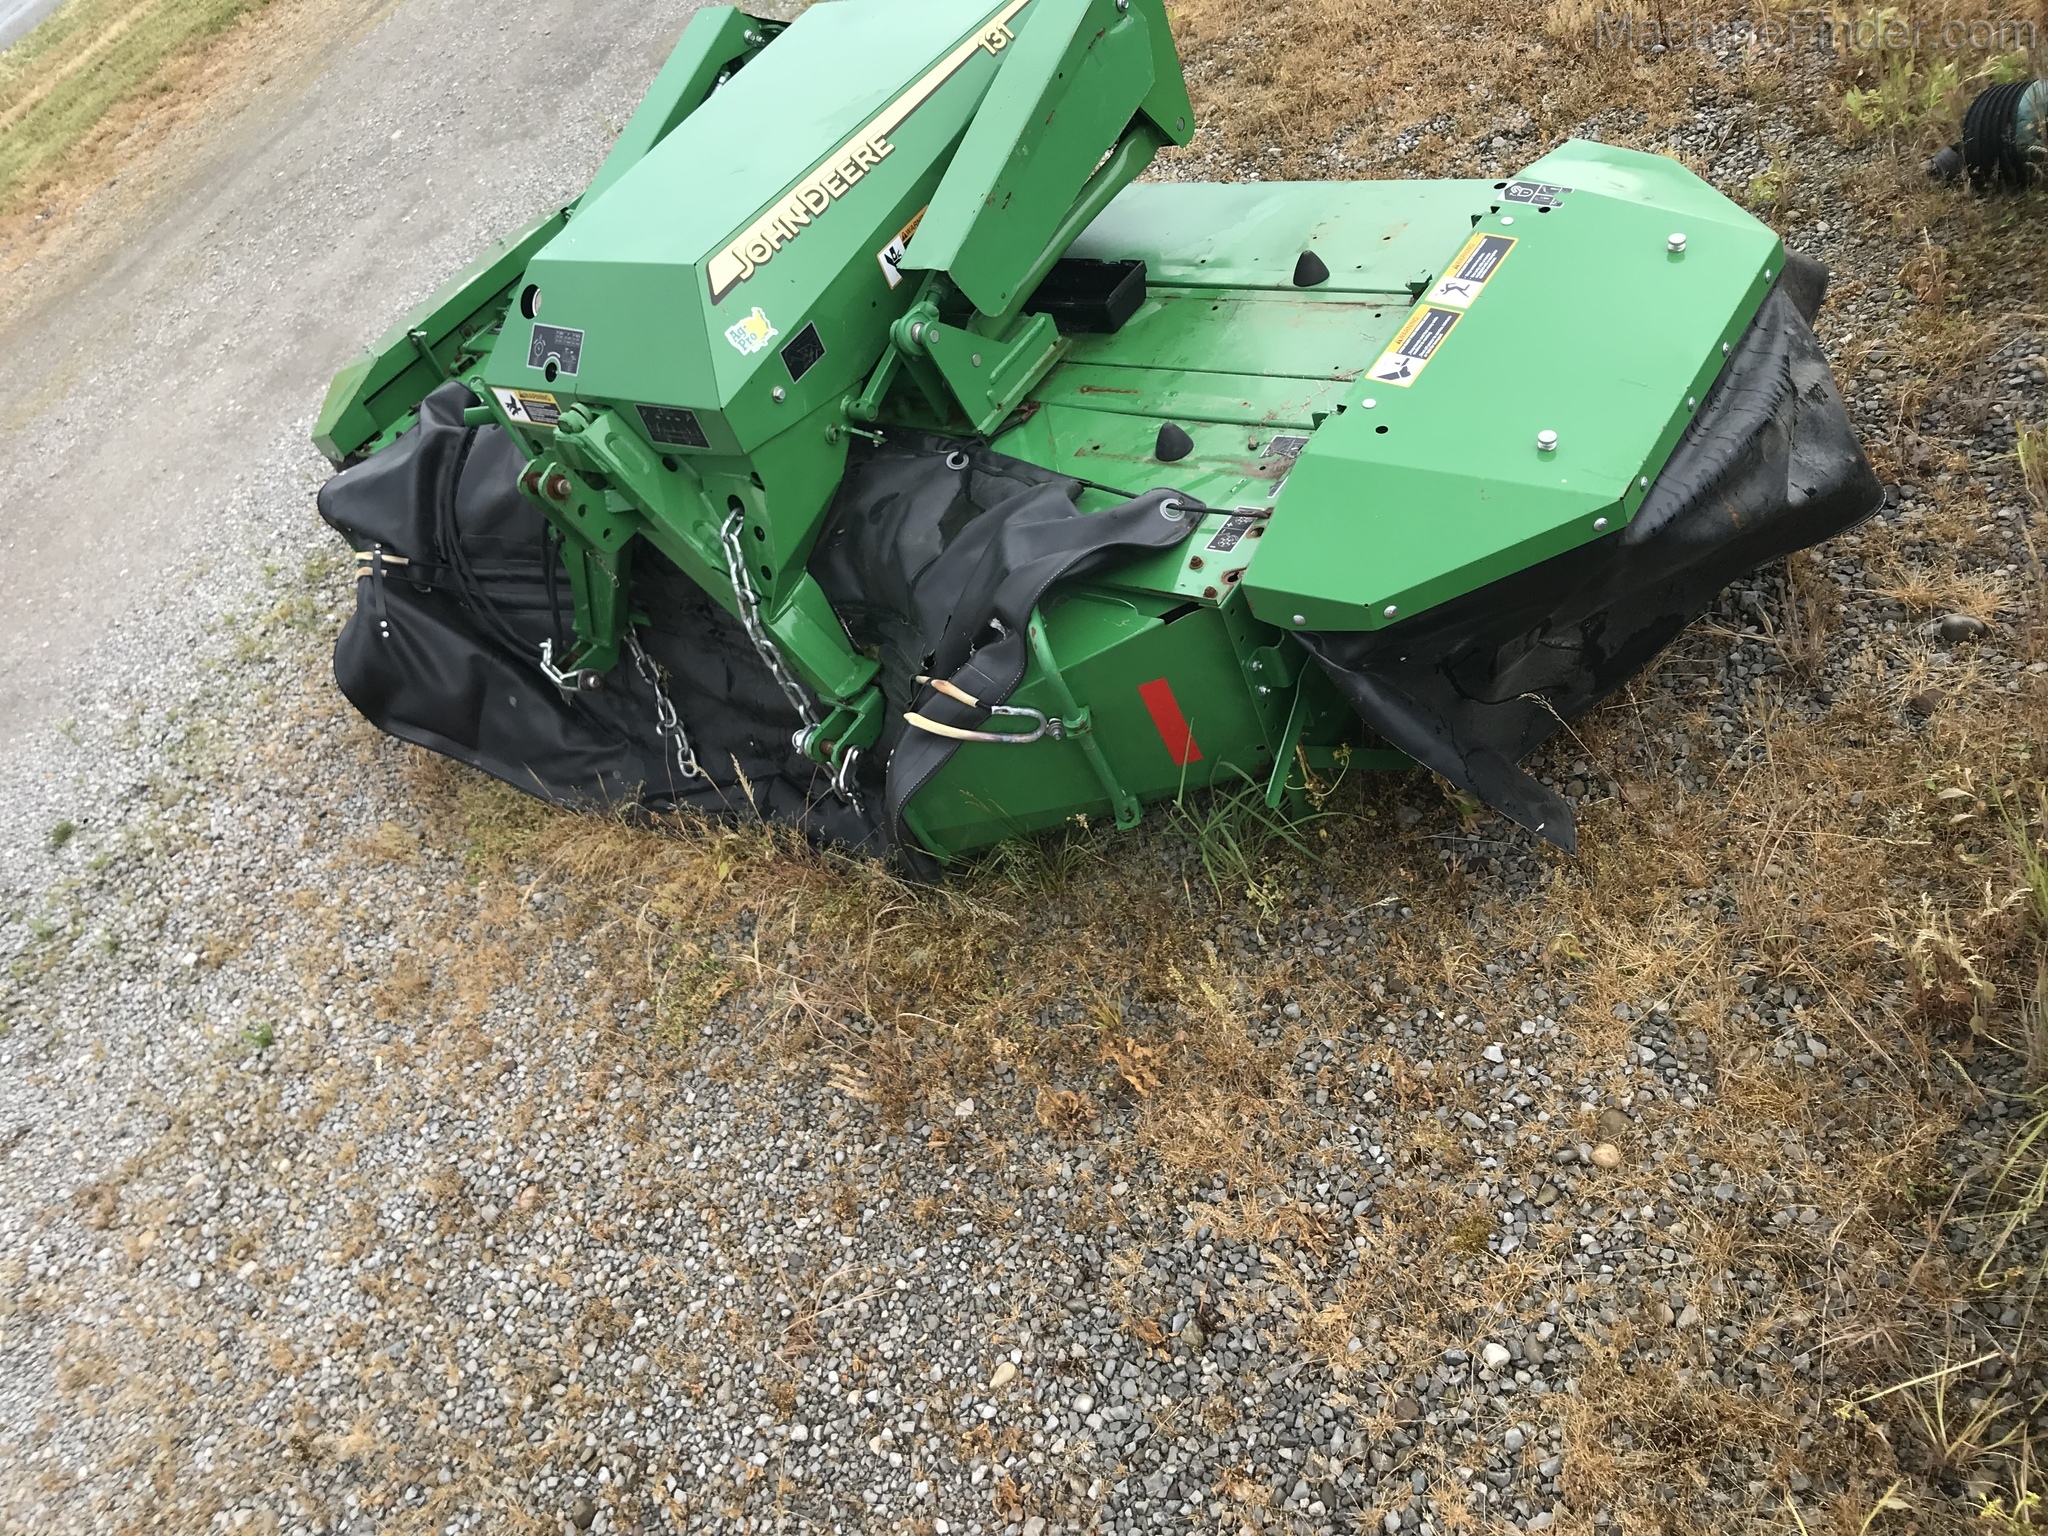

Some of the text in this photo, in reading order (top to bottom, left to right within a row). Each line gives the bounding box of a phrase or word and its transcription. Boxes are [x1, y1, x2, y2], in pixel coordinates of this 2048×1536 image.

[732, 131, 896, 282] JOHN DEERE
[737, 332, 757, 351] Pro
